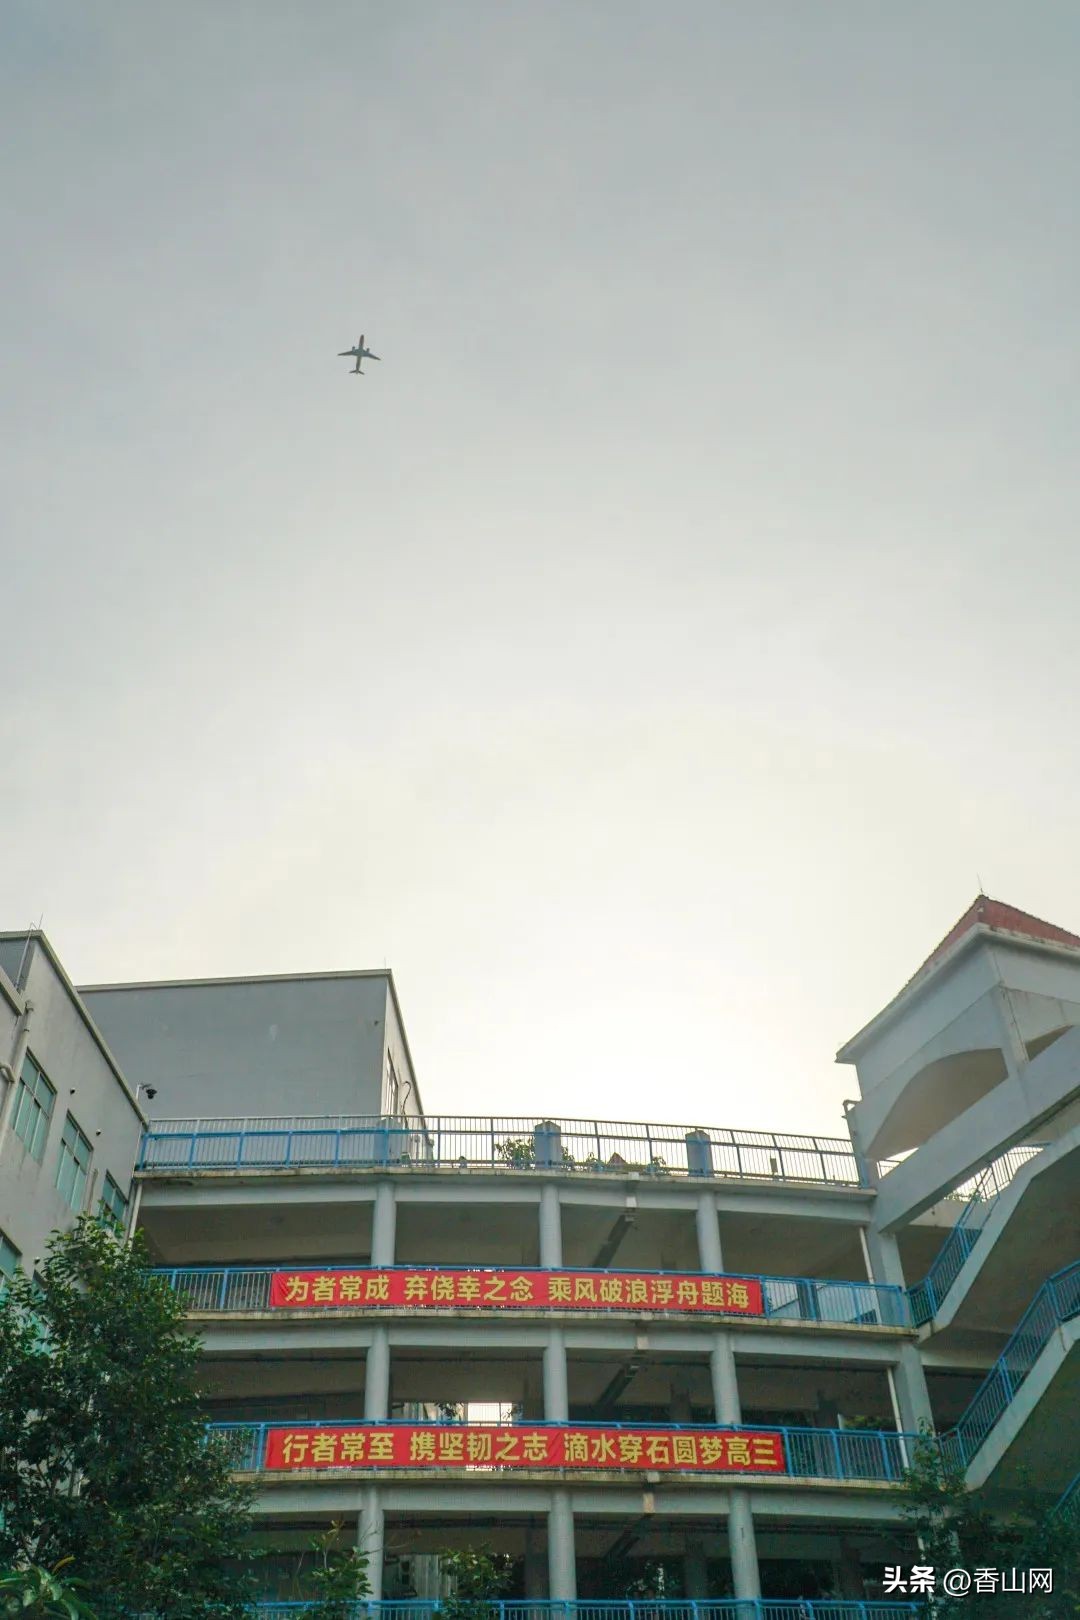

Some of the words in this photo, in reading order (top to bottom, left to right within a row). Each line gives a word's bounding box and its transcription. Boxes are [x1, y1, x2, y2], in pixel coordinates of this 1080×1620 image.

[284, 1275, 390, 1301] 为者常成
[403, 1275, 533, 1301] 弃侥幸之念
[548, 1276, 749, 1308] 乘风破浪浮舟题海
[282, 1432, 394, 1463] 行者常至
[410, 1432, 548, 1462] 携坚韧之志
[563, 1432, 777, 1466] 滴水穿石圆梦高三
